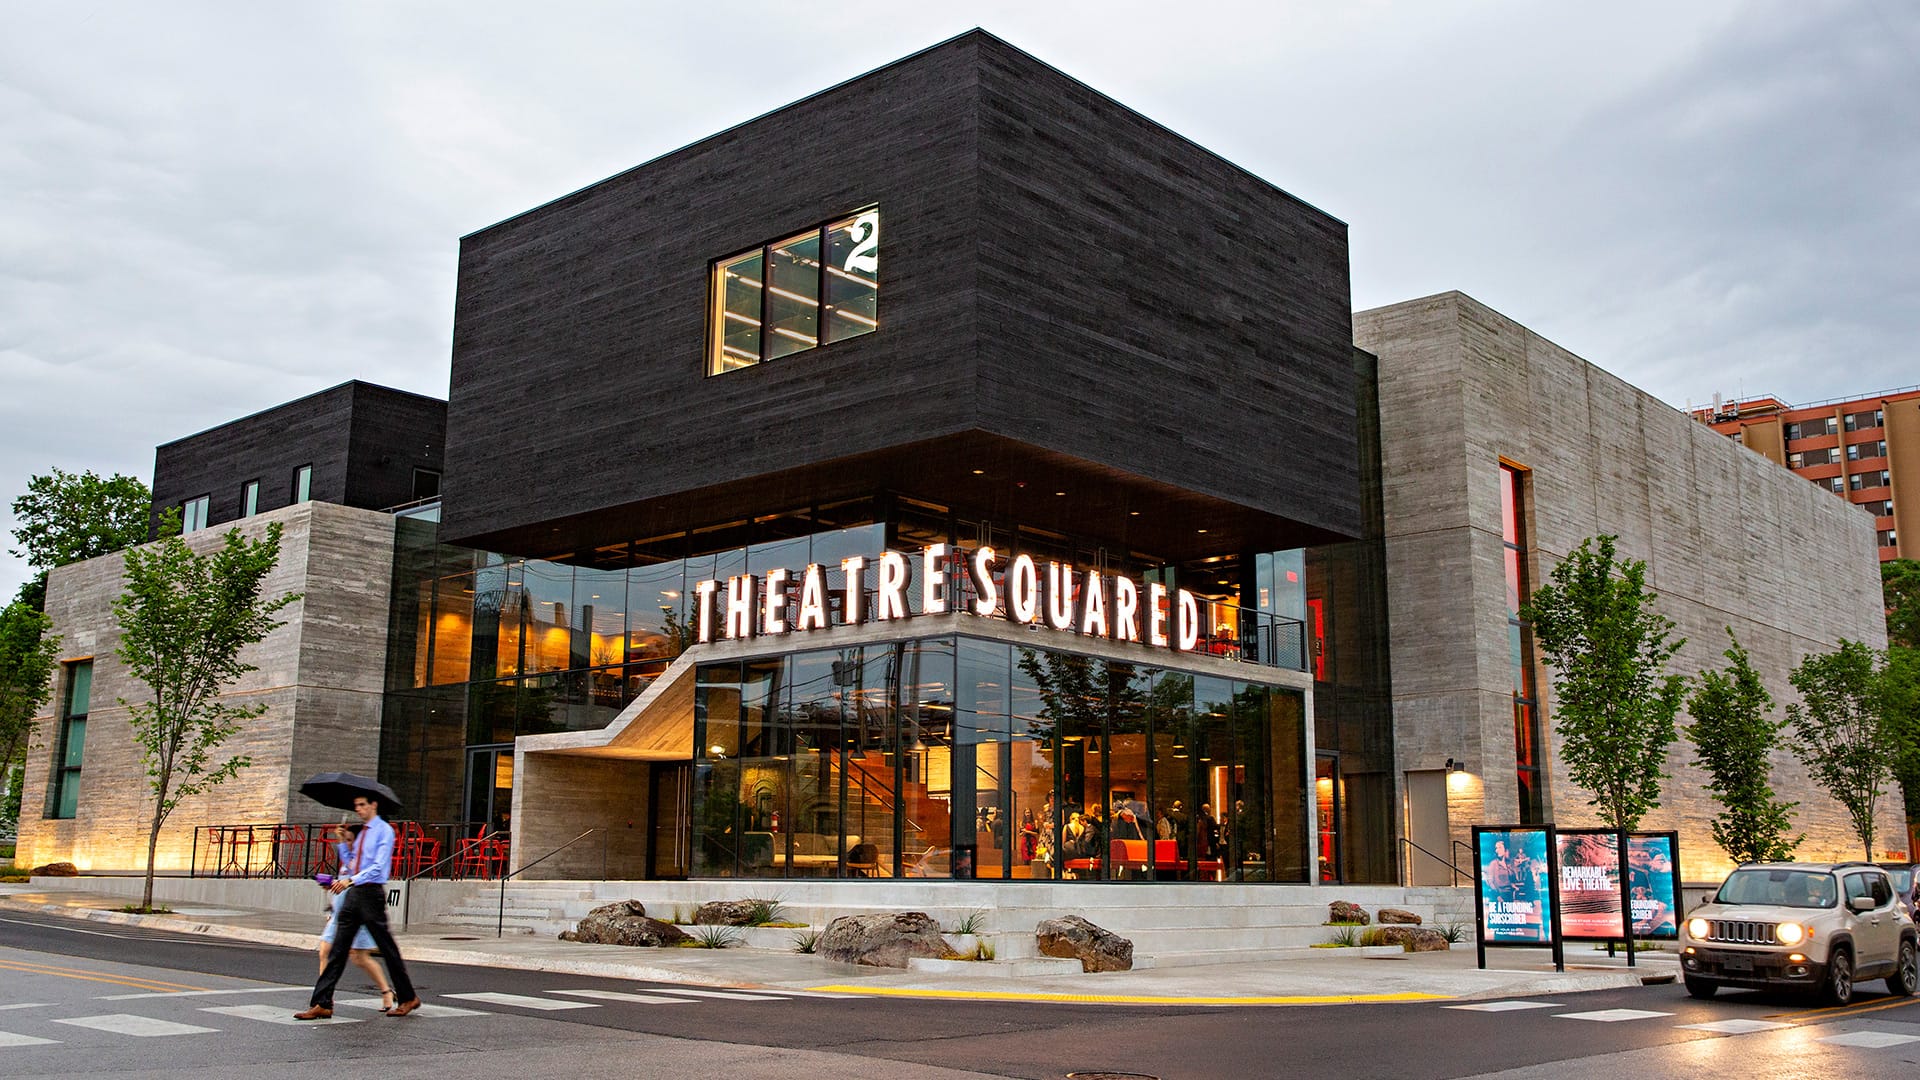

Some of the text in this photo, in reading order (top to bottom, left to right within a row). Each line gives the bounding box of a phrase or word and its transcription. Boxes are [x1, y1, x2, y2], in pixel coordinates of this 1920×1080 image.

[843, 212, 879, 273] 2
[696, 543, 1198, 650] THEATRE SQUARED
[1562, 866, 1607, 878] REMARKABLE
[1563, 878, 1581, 891] LIVE
[1497, 902, 1502, 912] A
[1503, 902, 1533, 913] FOUNDING
[1489, 913, 1526, 925] SUBSCRIBER
